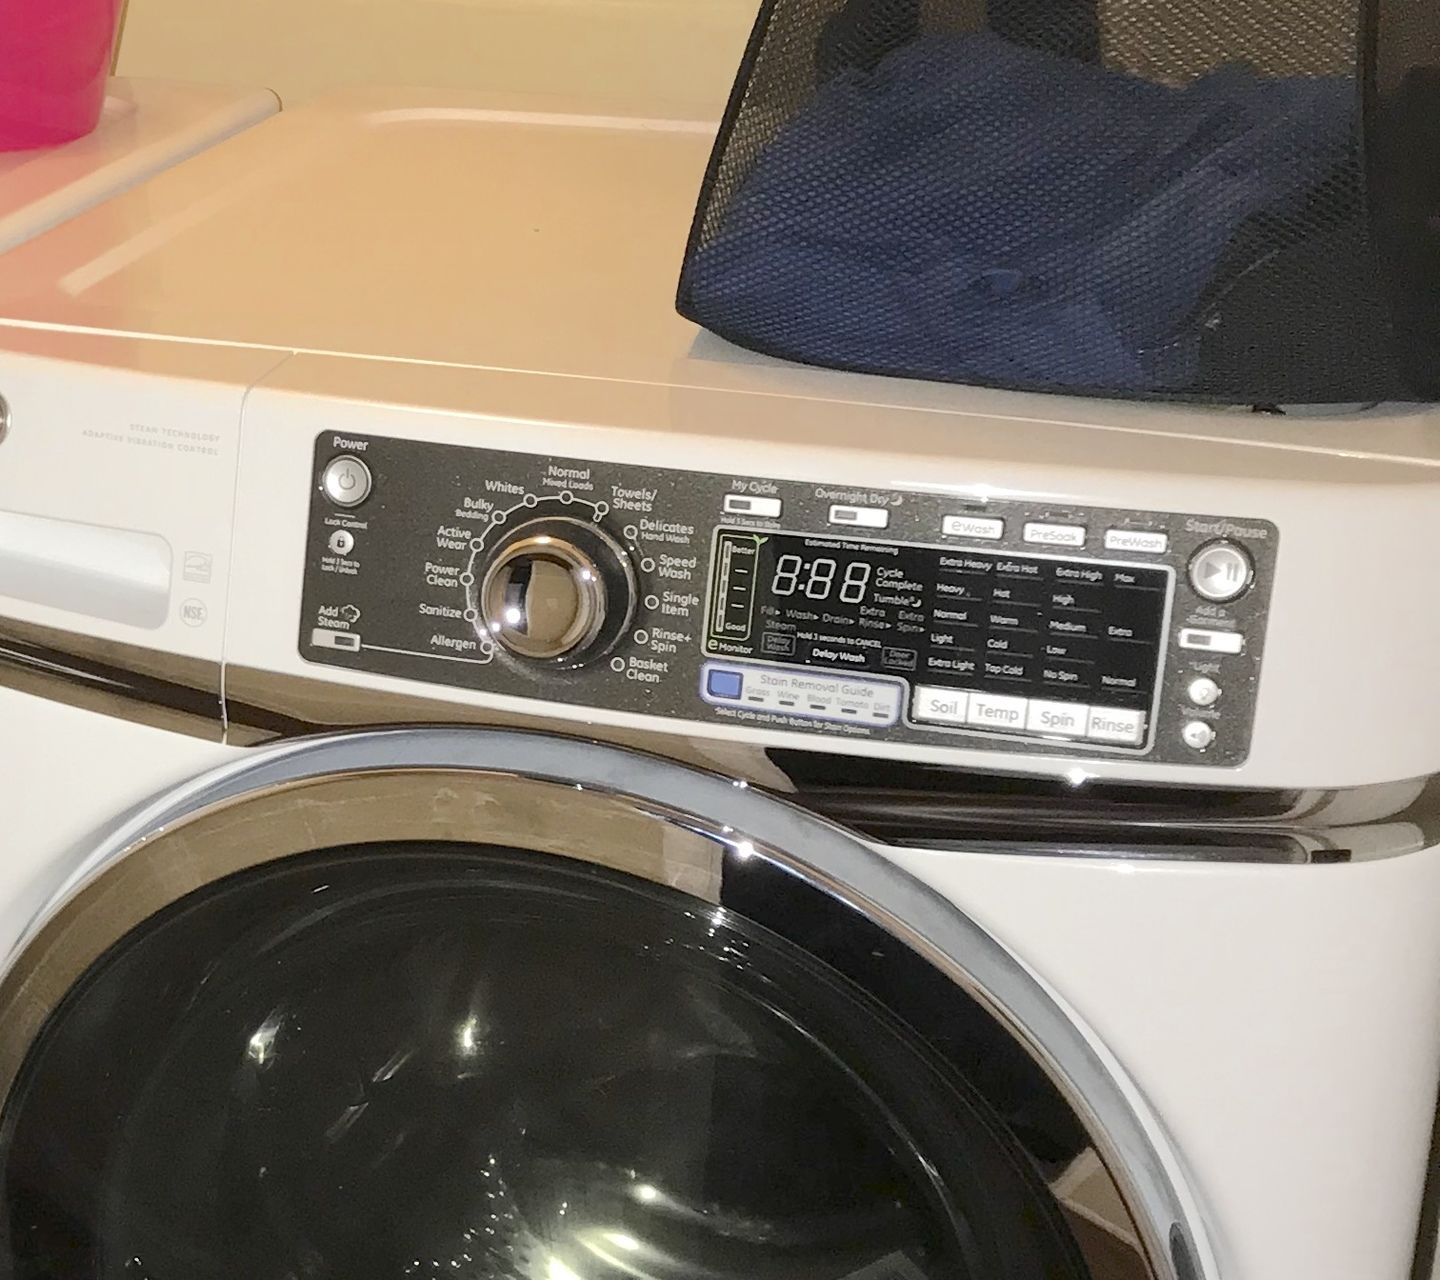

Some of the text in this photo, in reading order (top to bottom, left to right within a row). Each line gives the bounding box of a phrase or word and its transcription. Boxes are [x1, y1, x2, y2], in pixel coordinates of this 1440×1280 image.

[333, 436, 368, 451] Power
[548, 465, 590, 480] Normal
[485, 480, 524, 495] Whites
[568, 480, 593, 491] Loads
[732, 480, 779, 495] My Cycle
[611, 485, 658, 502] Towels/
[815, 488, 890, 507] Overnight Dry
[464, 497, 494, 512] Bulky
[612, 498, 653, 512] Sheets
[455, 509, 489, 522] Bedding
[438, 525, 472, 539] Active
[639, 519, 694, 535] Delicates
[951, 520, 996, 535] eWash
[1185, 519, 1268, 539] Start/Pause
[641, 531, 690, 544] Hand Wash
[1031, 527, 1077, 543] PreSoak
[1110, 534, 1162, 549] PreWash
[437, 537, 467, 551] Wear
[732, 546, 755, 555] Better
[842, 540, 859, 551] Time
[660, 554, 696, 570] Speed
[940, 556, 993, 571] Extra Heavy
[996, 562, 1038, 574] Extra Hot
[425, 562, 460, 577] Power
[659, 567, 691, 581] Wash
[877, 567, 904, 579] Cycle
[1056, 568, 1103, 582] Extra High
[426, 574, 458, 587] Clean
[771, 554, 871, 604] 8:88
[875, 577, 923, 592] Complete
[937, 582, 965, 596] Heavy
[993, 588, 1010, 599] Hot
[663, 591, 699, 608] Single
[874, 594, 910, 606] Tumble
[1052, 594, 1075, 606] High
[318, 605, 338, 617] Add
[419, 603, 462, 618] Sanitize
[662, 603, 689, 617] Item
[786, 609, 849, 624] Wash Drain
[860, 606, 925, 622] Extra Extra
[934, 608, 967, 620] Normal
[1195, 605, 1215, 616] Add
[318, 617, 350, 630] Steam
[725, 622, 746, 632] Good
[765, 620, 796, 631] Steam
[990, 614, 1019, 626] Warm
[1048, 620, 1087, 633] Medium
[652, 627, 692, 642] Rinse+
[1108, 625, 1133, 637] Extra
[430, 635, 476, 651] Allergen
[650, 639, 677, 654] Spin
[930, 634, 954, 645] Light
[987, 639, 1008, 650] Cold
[719, 642, 753, 654] Monitor
[1046, 645, 1067, 656] Low
[812, 648, 865, 664] Delay Wash
[629, 657, 669, 672] Basket
[928, 657, 975, 671] Extra Light
[985, 663, 1023, 676] Tap Cold
[626, 669, 660, 683] Clean
[1043, 669, 1078, 683] No Spin
[1102, 675, 1137, 688] Normal
[760, 675, 874, 698] Stain Removal Guide
[777, 691, 799, 701] Wine
[874, 703, 890, 711] Dirt
[930, 700, 957, 716] Soil
[976, 703, 1019, 722] Temp
[1041, 711, 1075, 729] Spin
[1092, 717, 1134, 734] Rinse
